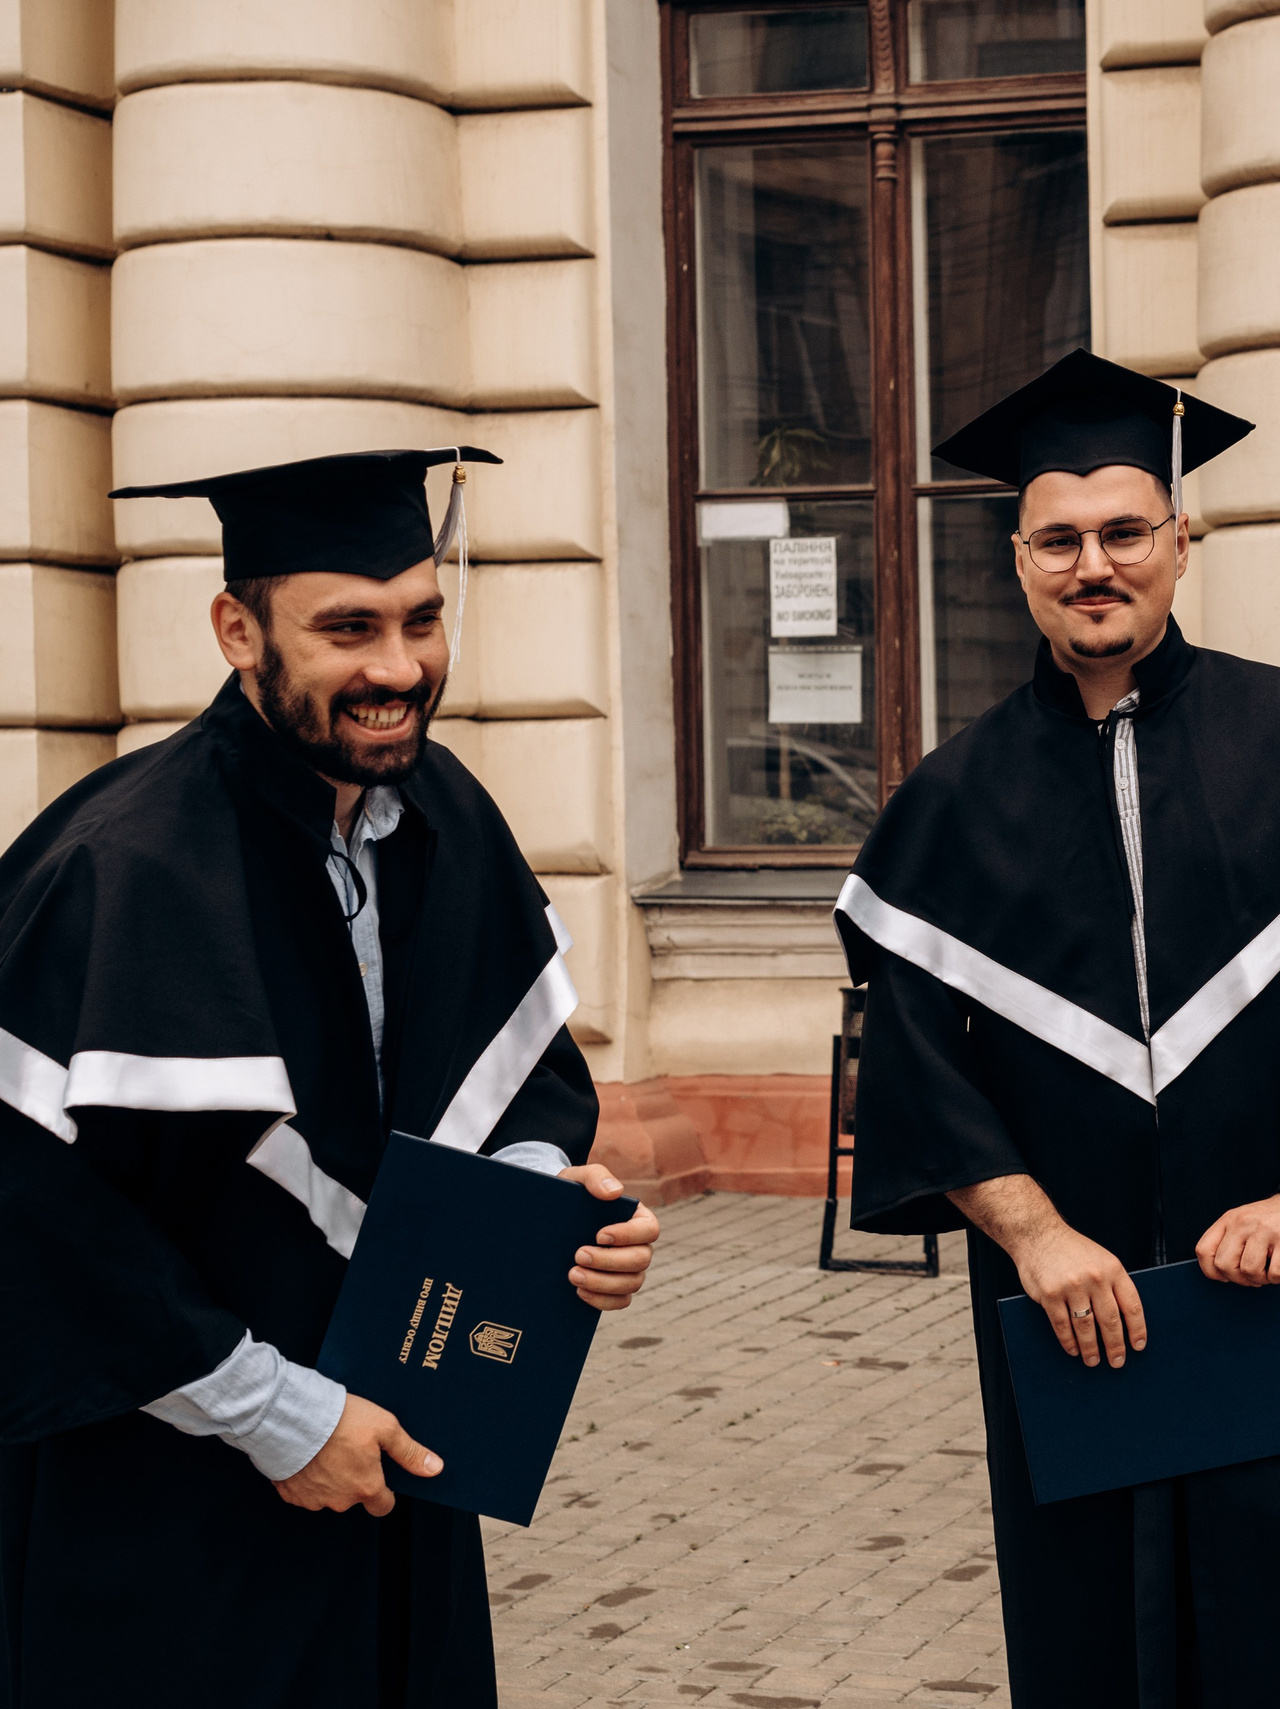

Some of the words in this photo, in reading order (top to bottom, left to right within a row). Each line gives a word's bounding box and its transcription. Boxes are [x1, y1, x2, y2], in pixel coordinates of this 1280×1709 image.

[776, 610, 790, 622] NO
[792, 608, 833, 622] SMOKING
[420, 1277, 434, 1299] ПРО
[409, 1299, 427, 1329] ВИЩУ
[422, 1282, 463, 1370] ДИПЛОМ
[398, 1328, 417, 1364] ОСВІТУ
